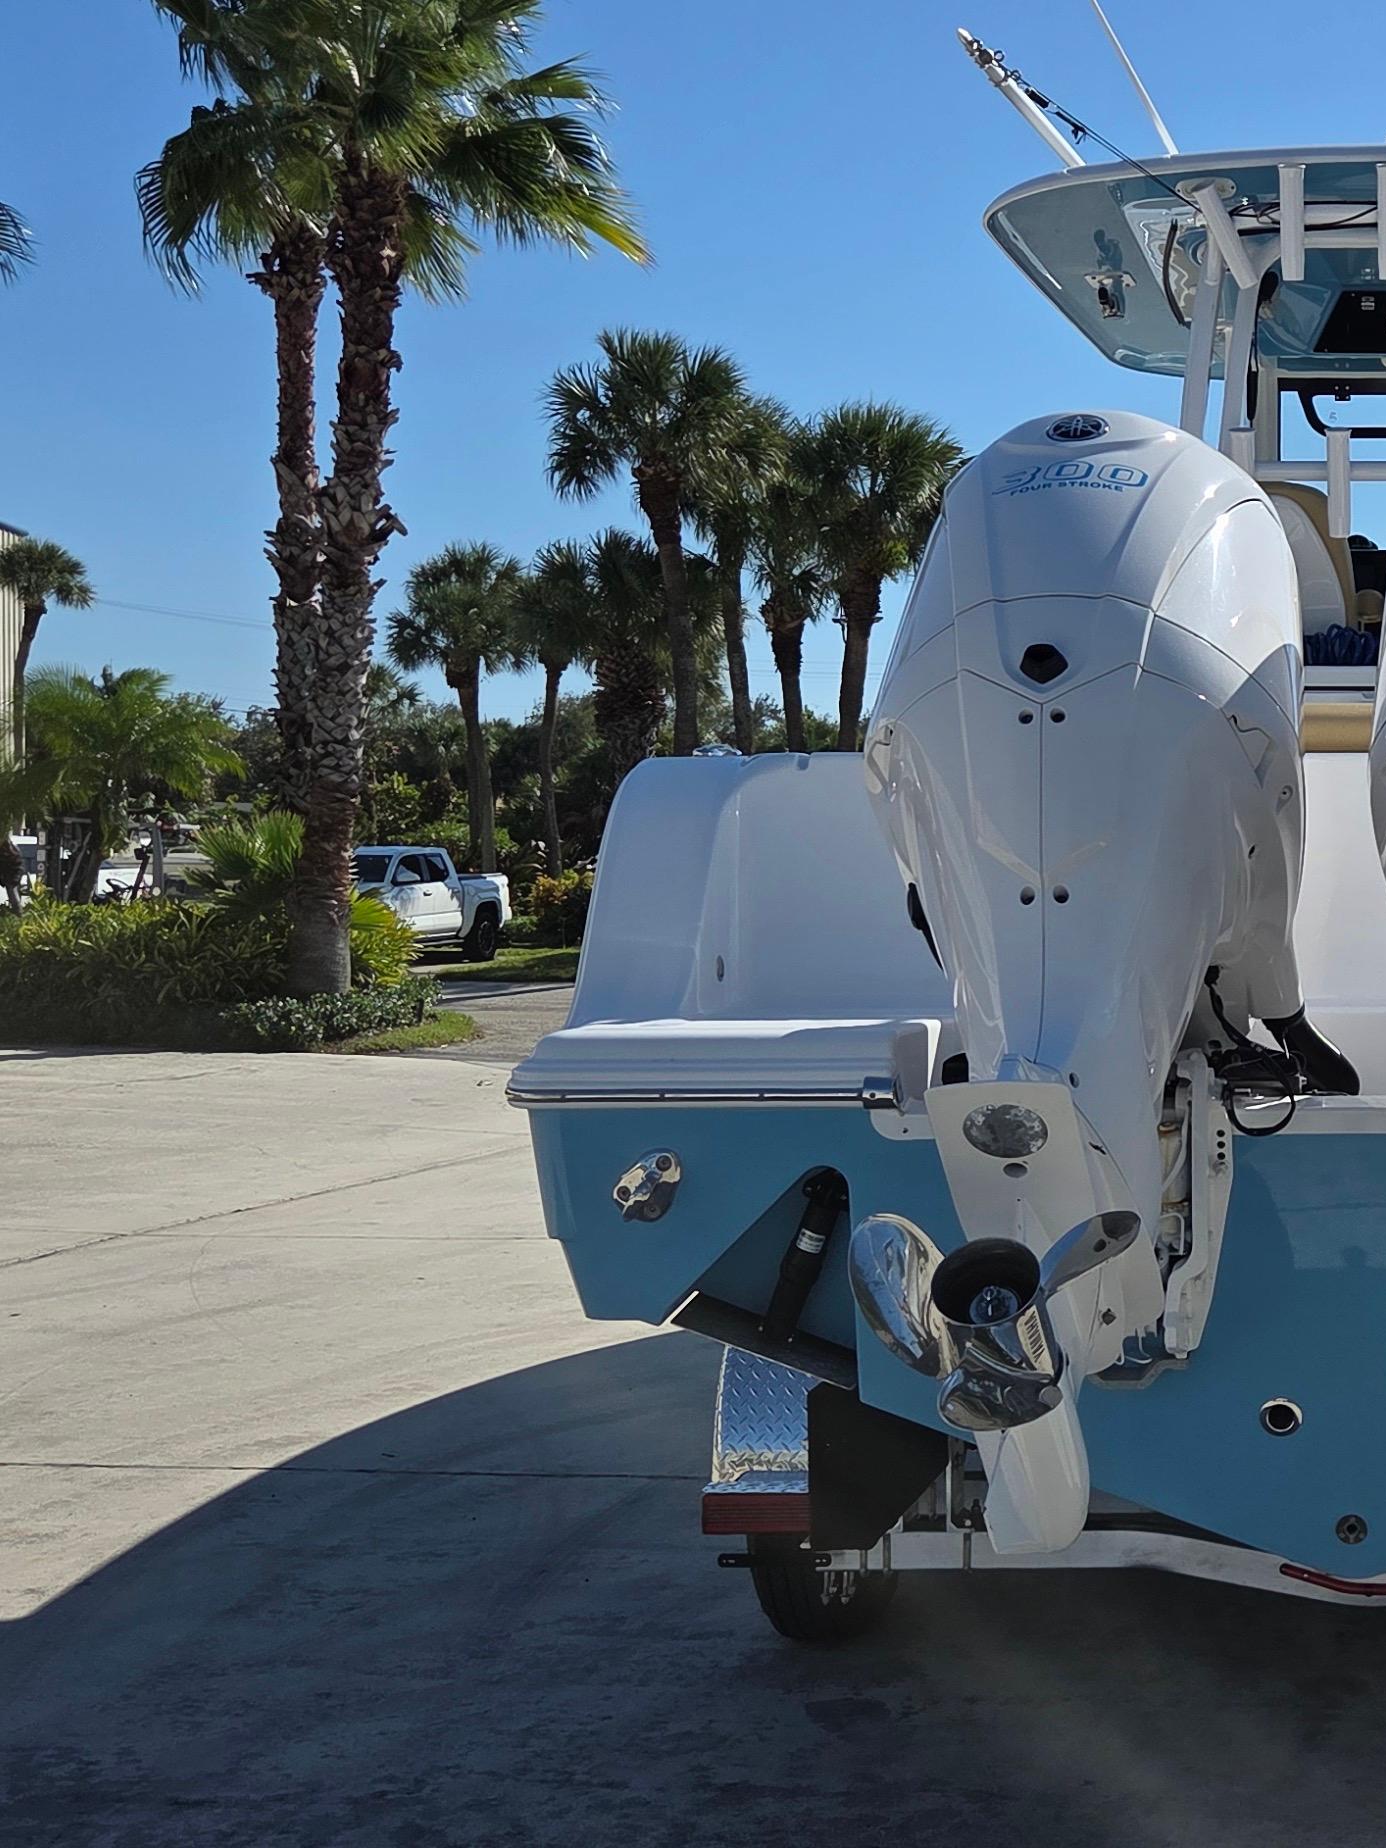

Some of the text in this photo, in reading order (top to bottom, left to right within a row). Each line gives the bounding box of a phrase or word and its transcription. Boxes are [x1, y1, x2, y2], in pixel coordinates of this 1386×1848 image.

[992, 460, 1149, 496] 300
[1010, 480, 1125, 497] FOUR STROKE
[1024, 1310, 1046, 1364] YAMAHA
